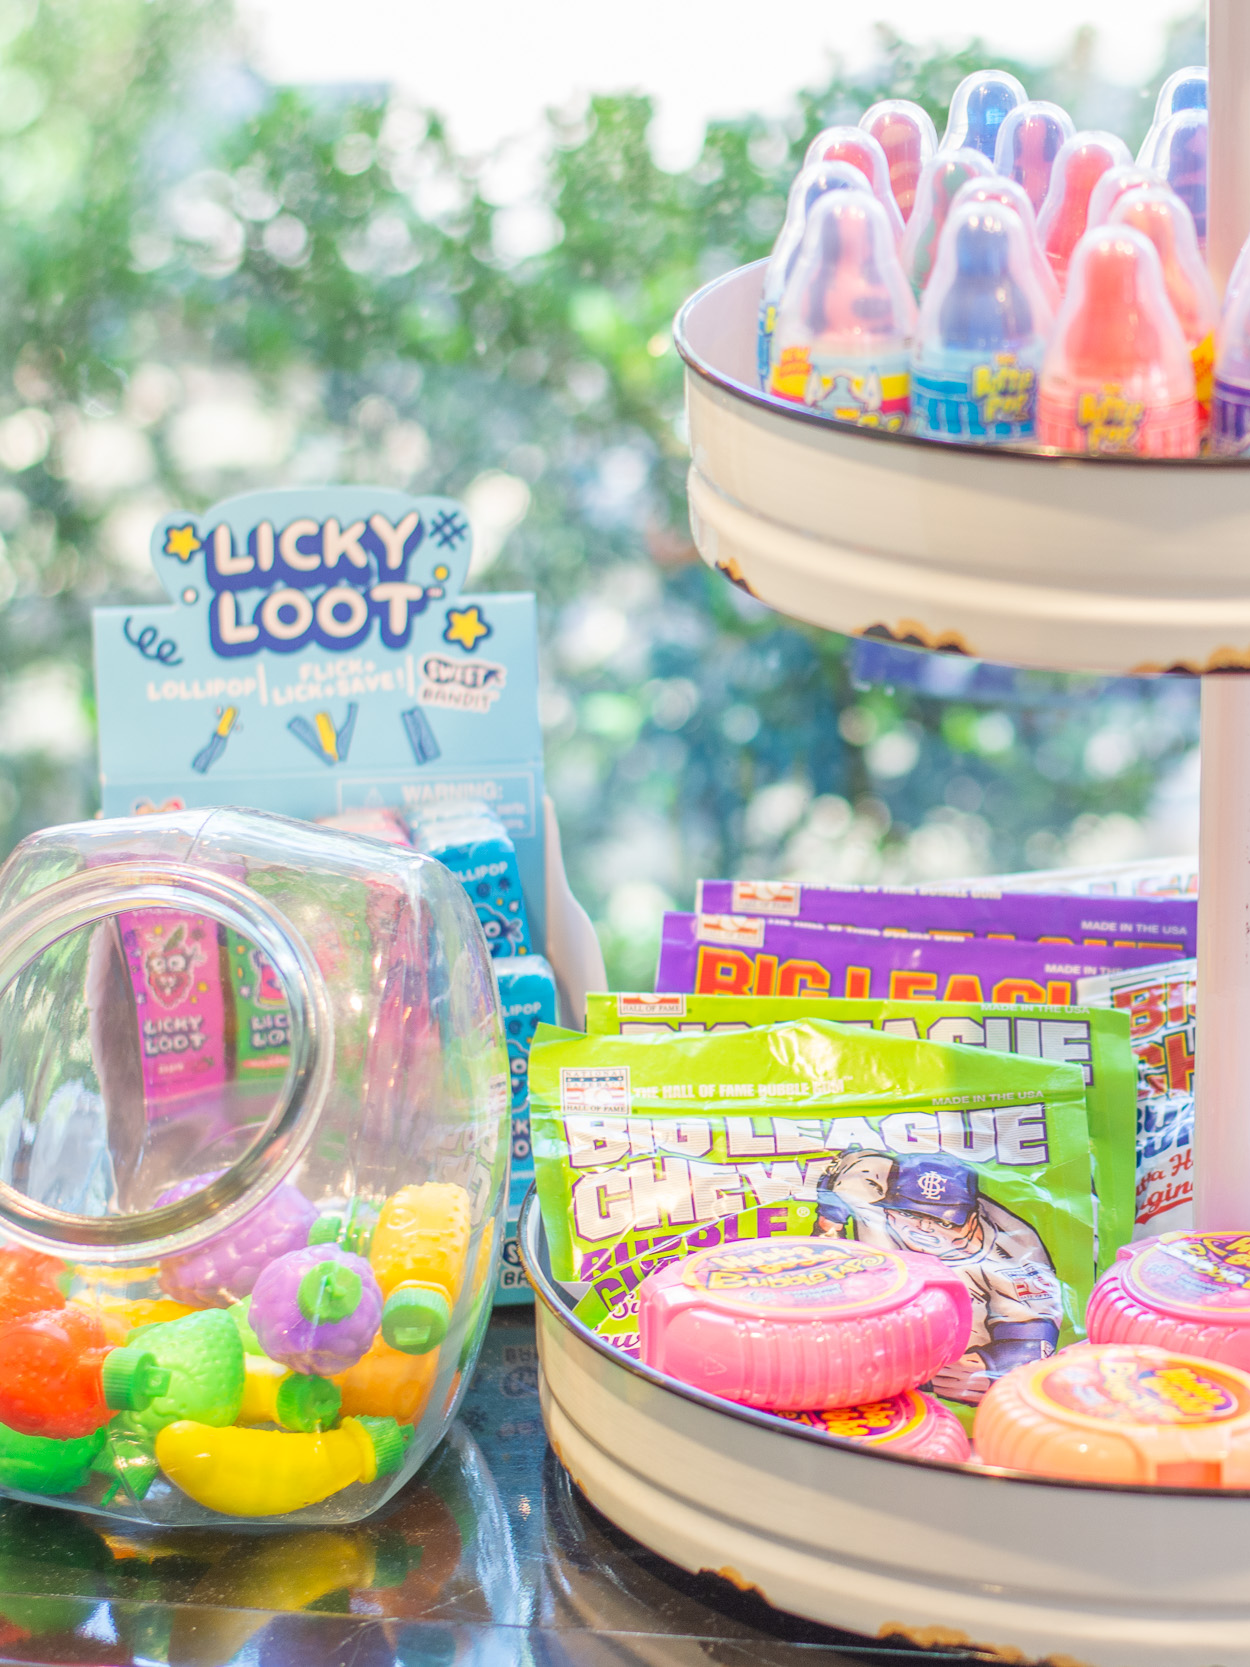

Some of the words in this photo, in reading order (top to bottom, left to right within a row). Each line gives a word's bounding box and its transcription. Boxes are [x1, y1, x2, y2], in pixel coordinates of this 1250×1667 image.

[212, 511, 422, 577] LICKY
[217, 581, 424, 646] LOOT
[146, 676, 257, 702] LOLLIPOP
[422, 687, 490, 710] BANDIT
[455, 861, 508, 883] LLIPOP
[1081, 920, 1117, 932] MADE
[1119, 923, 1134, 934] IN
[1136, 924, 1160, 935] THE
[1162, 925, 1187, 936] USA
[1044, 963, 1080, 975] MADE
[1083, 965, 1098, 976] IN
[622, 1005, 644, 1013] HALL
[646, 1005, 658, 1013] OF
[659, 1004, 681, 1013] FAME
[1037, 1004, 1061, 1014] THE
[1064, 1005, 1090, 1015] USA
[1111, 974, 1197, 1039] BI
[143, 1015, 204, 1036] LICKY
[144, 1034, 207, 1057] LOOT
[633, 1086, 660, 1098] THE
[662, 1084, 695, 1099] HALL
[699, 1084, 715, 1098] OF
[718, 1083, 755, 1098] FAME
[757, 1082, 810, 1097] BUBBLE
[932, 1094, 972, 1107] MADE
[975, 1093, 988, 1105] IN
[989, 1092, 1014, 1104] THE
[1015, 1090, 1045, 1103] USA
[566, 1104, 588, 1113] HALL
[590, 1104, 601, 1112] OF
[603, 1104, 627, 1113] FAME
[563, 1115, 714, 1168] BIG
[722, 1103, 1050, 1167] LEAGUE
[572, 1154, 833, 1243] CHEW
